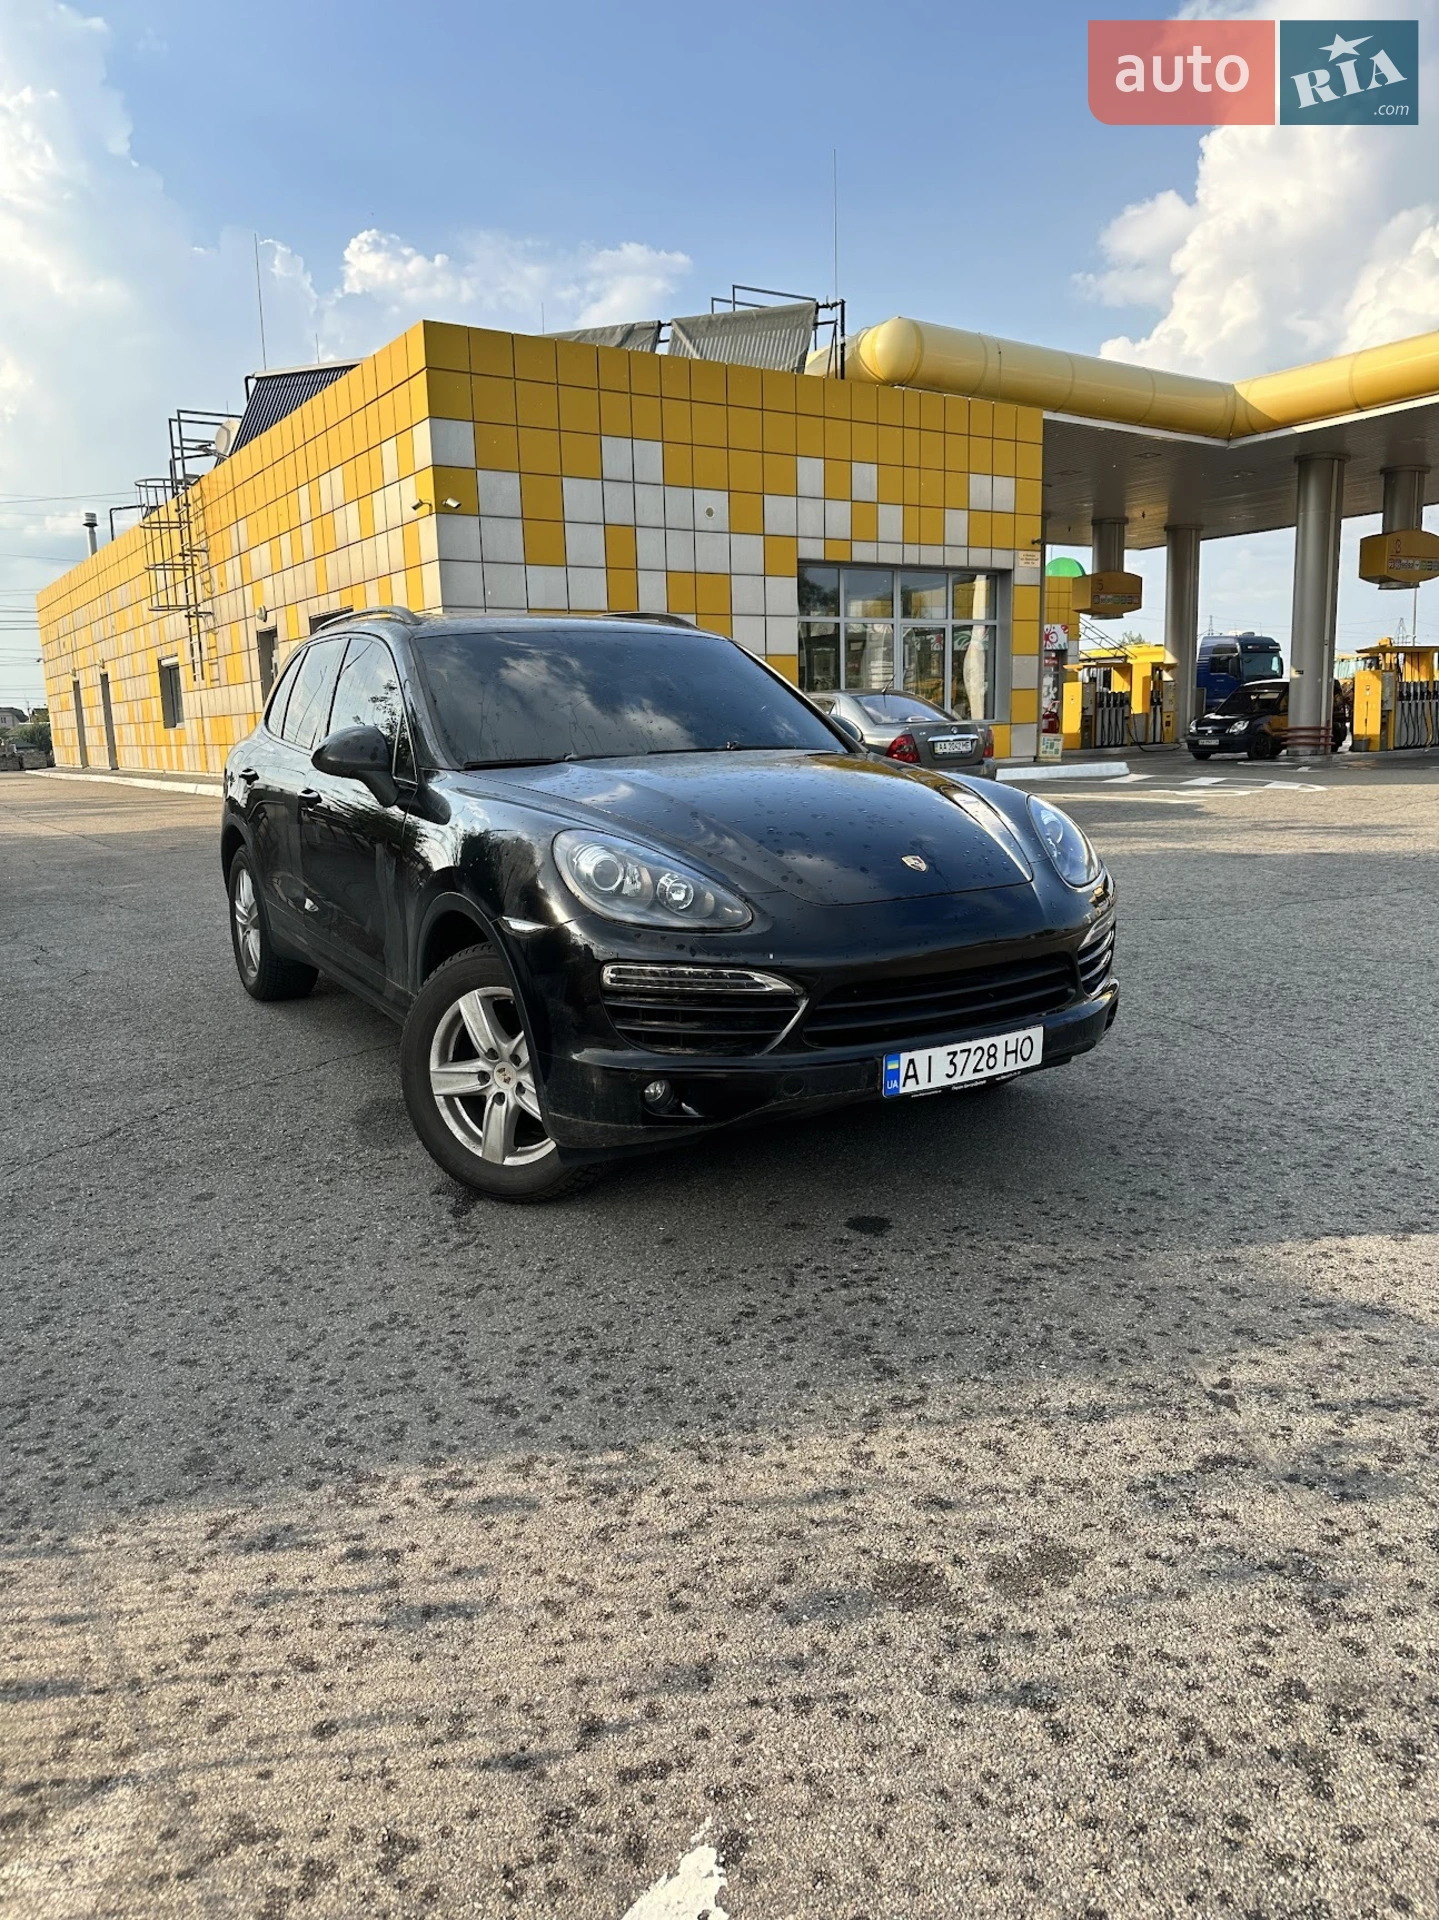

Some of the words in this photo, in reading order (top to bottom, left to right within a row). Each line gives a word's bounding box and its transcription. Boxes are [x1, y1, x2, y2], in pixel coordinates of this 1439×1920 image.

[902, 1055, 932, 1087] AI
[945, 1043, 998, 1079] 3728
[1003, 1035, 1034, 1067] HO
[887, 1081, 898, 1089] UA
